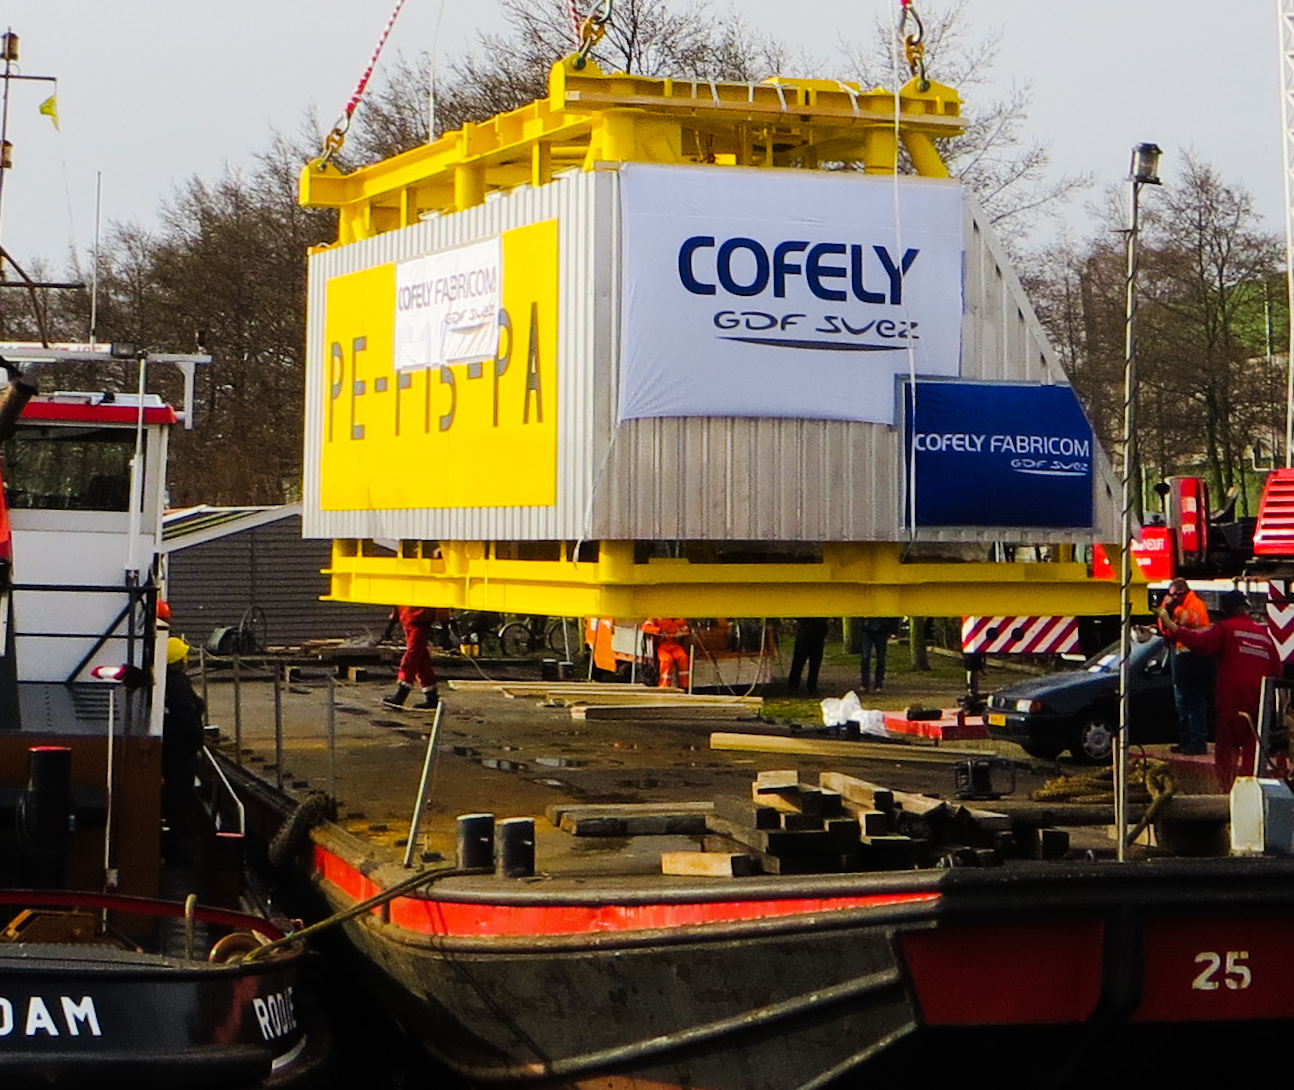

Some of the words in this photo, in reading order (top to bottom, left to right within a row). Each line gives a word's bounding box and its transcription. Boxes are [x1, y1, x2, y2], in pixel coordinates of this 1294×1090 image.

[678, 236, 920, 305] COFELY
[398, 280, 433, 311] COFELY
[434, 266, 496, 305] FABRICOM
[713, 311, 806, 331] GDF
[914, 433, 986, 452] COFELY
[990, 435, 1090, 457] FABRICOM
[1011, 459, 1047, 468] GDF
[1192, 951, 1251, 990] 25
